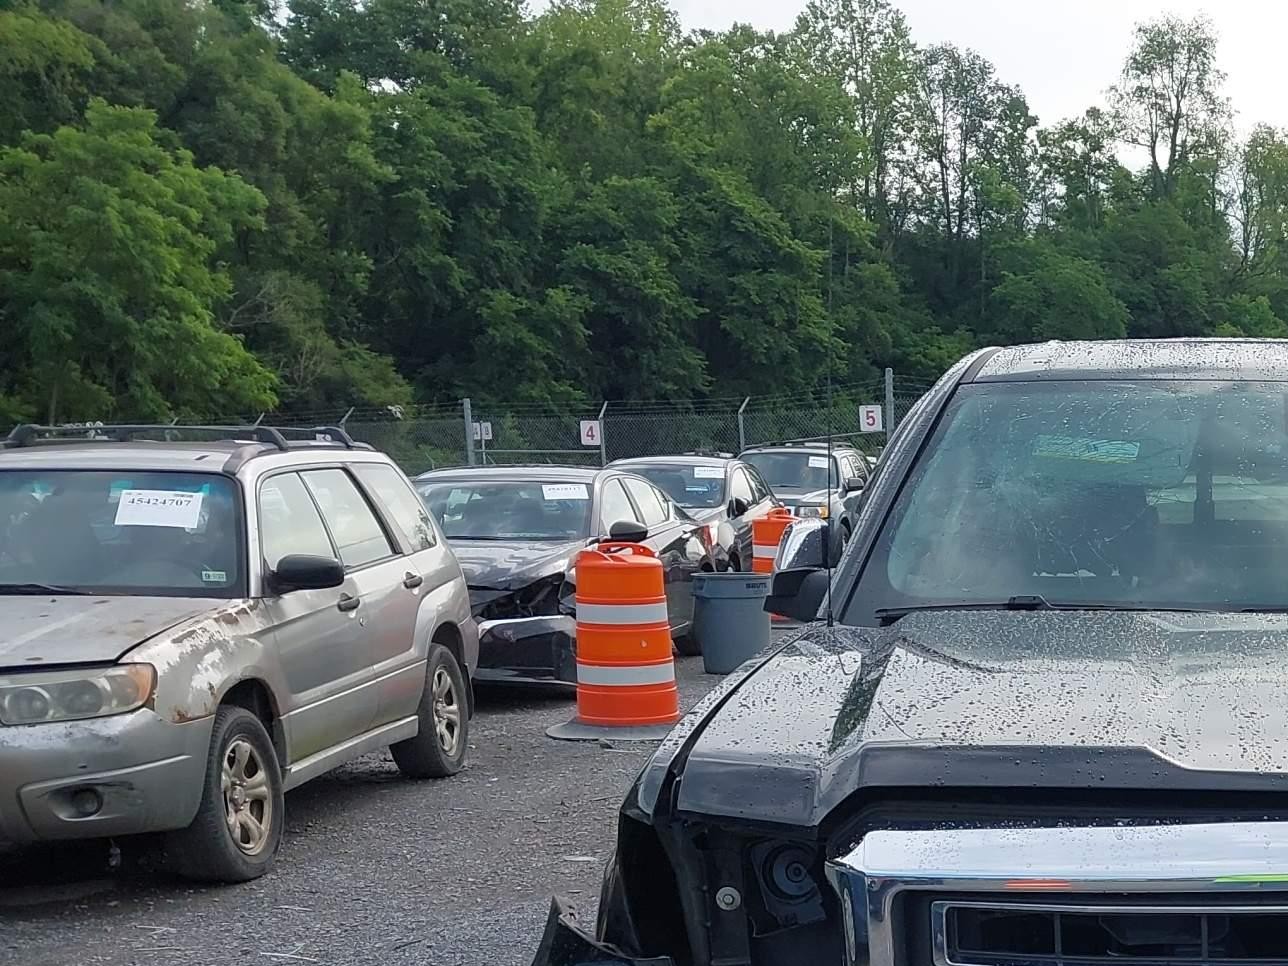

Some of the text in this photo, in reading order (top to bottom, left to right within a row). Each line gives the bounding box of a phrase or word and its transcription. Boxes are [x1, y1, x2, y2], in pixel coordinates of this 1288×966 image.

[866, 410, 876, 426] 5
[586, 425, 595, 440] 4
[128, 497, 192, 507] 45424707
